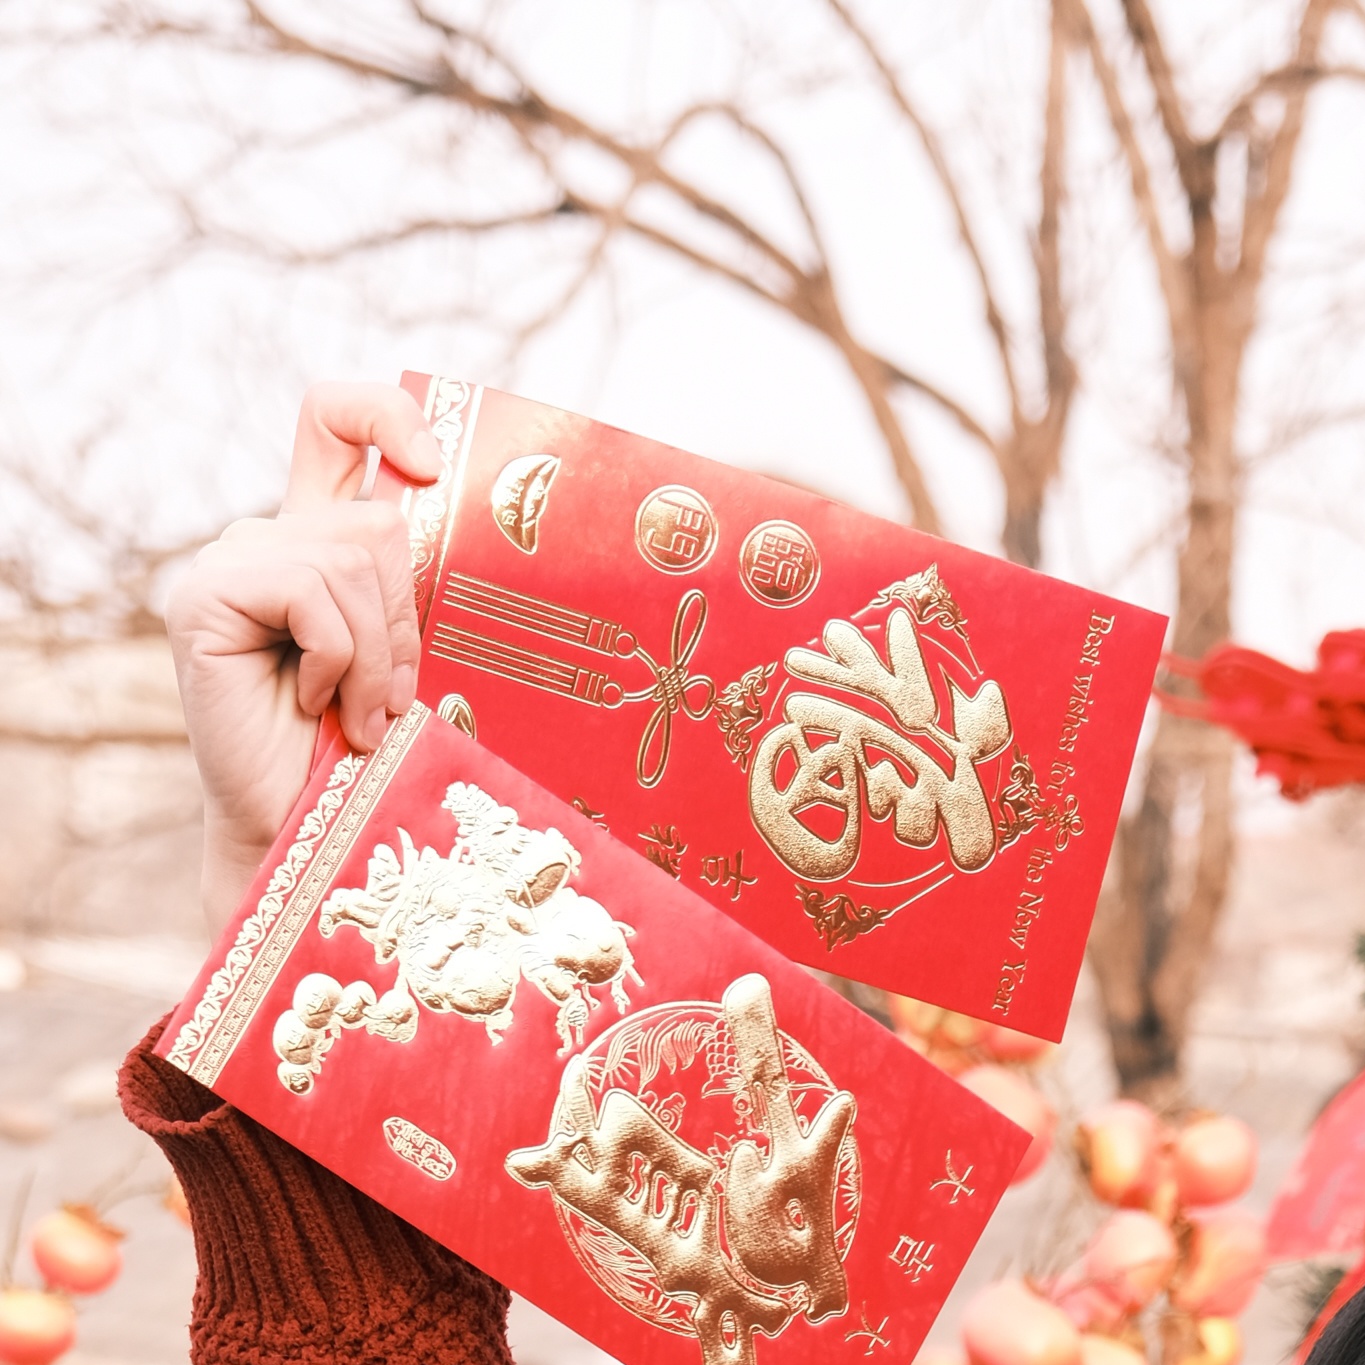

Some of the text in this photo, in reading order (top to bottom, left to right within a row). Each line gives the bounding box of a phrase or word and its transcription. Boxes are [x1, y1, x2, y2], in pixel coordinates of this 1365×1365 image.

[750, 608, 1013, 882] 福
[991, 609, 1115, 1017] Best wishes for the New Year
